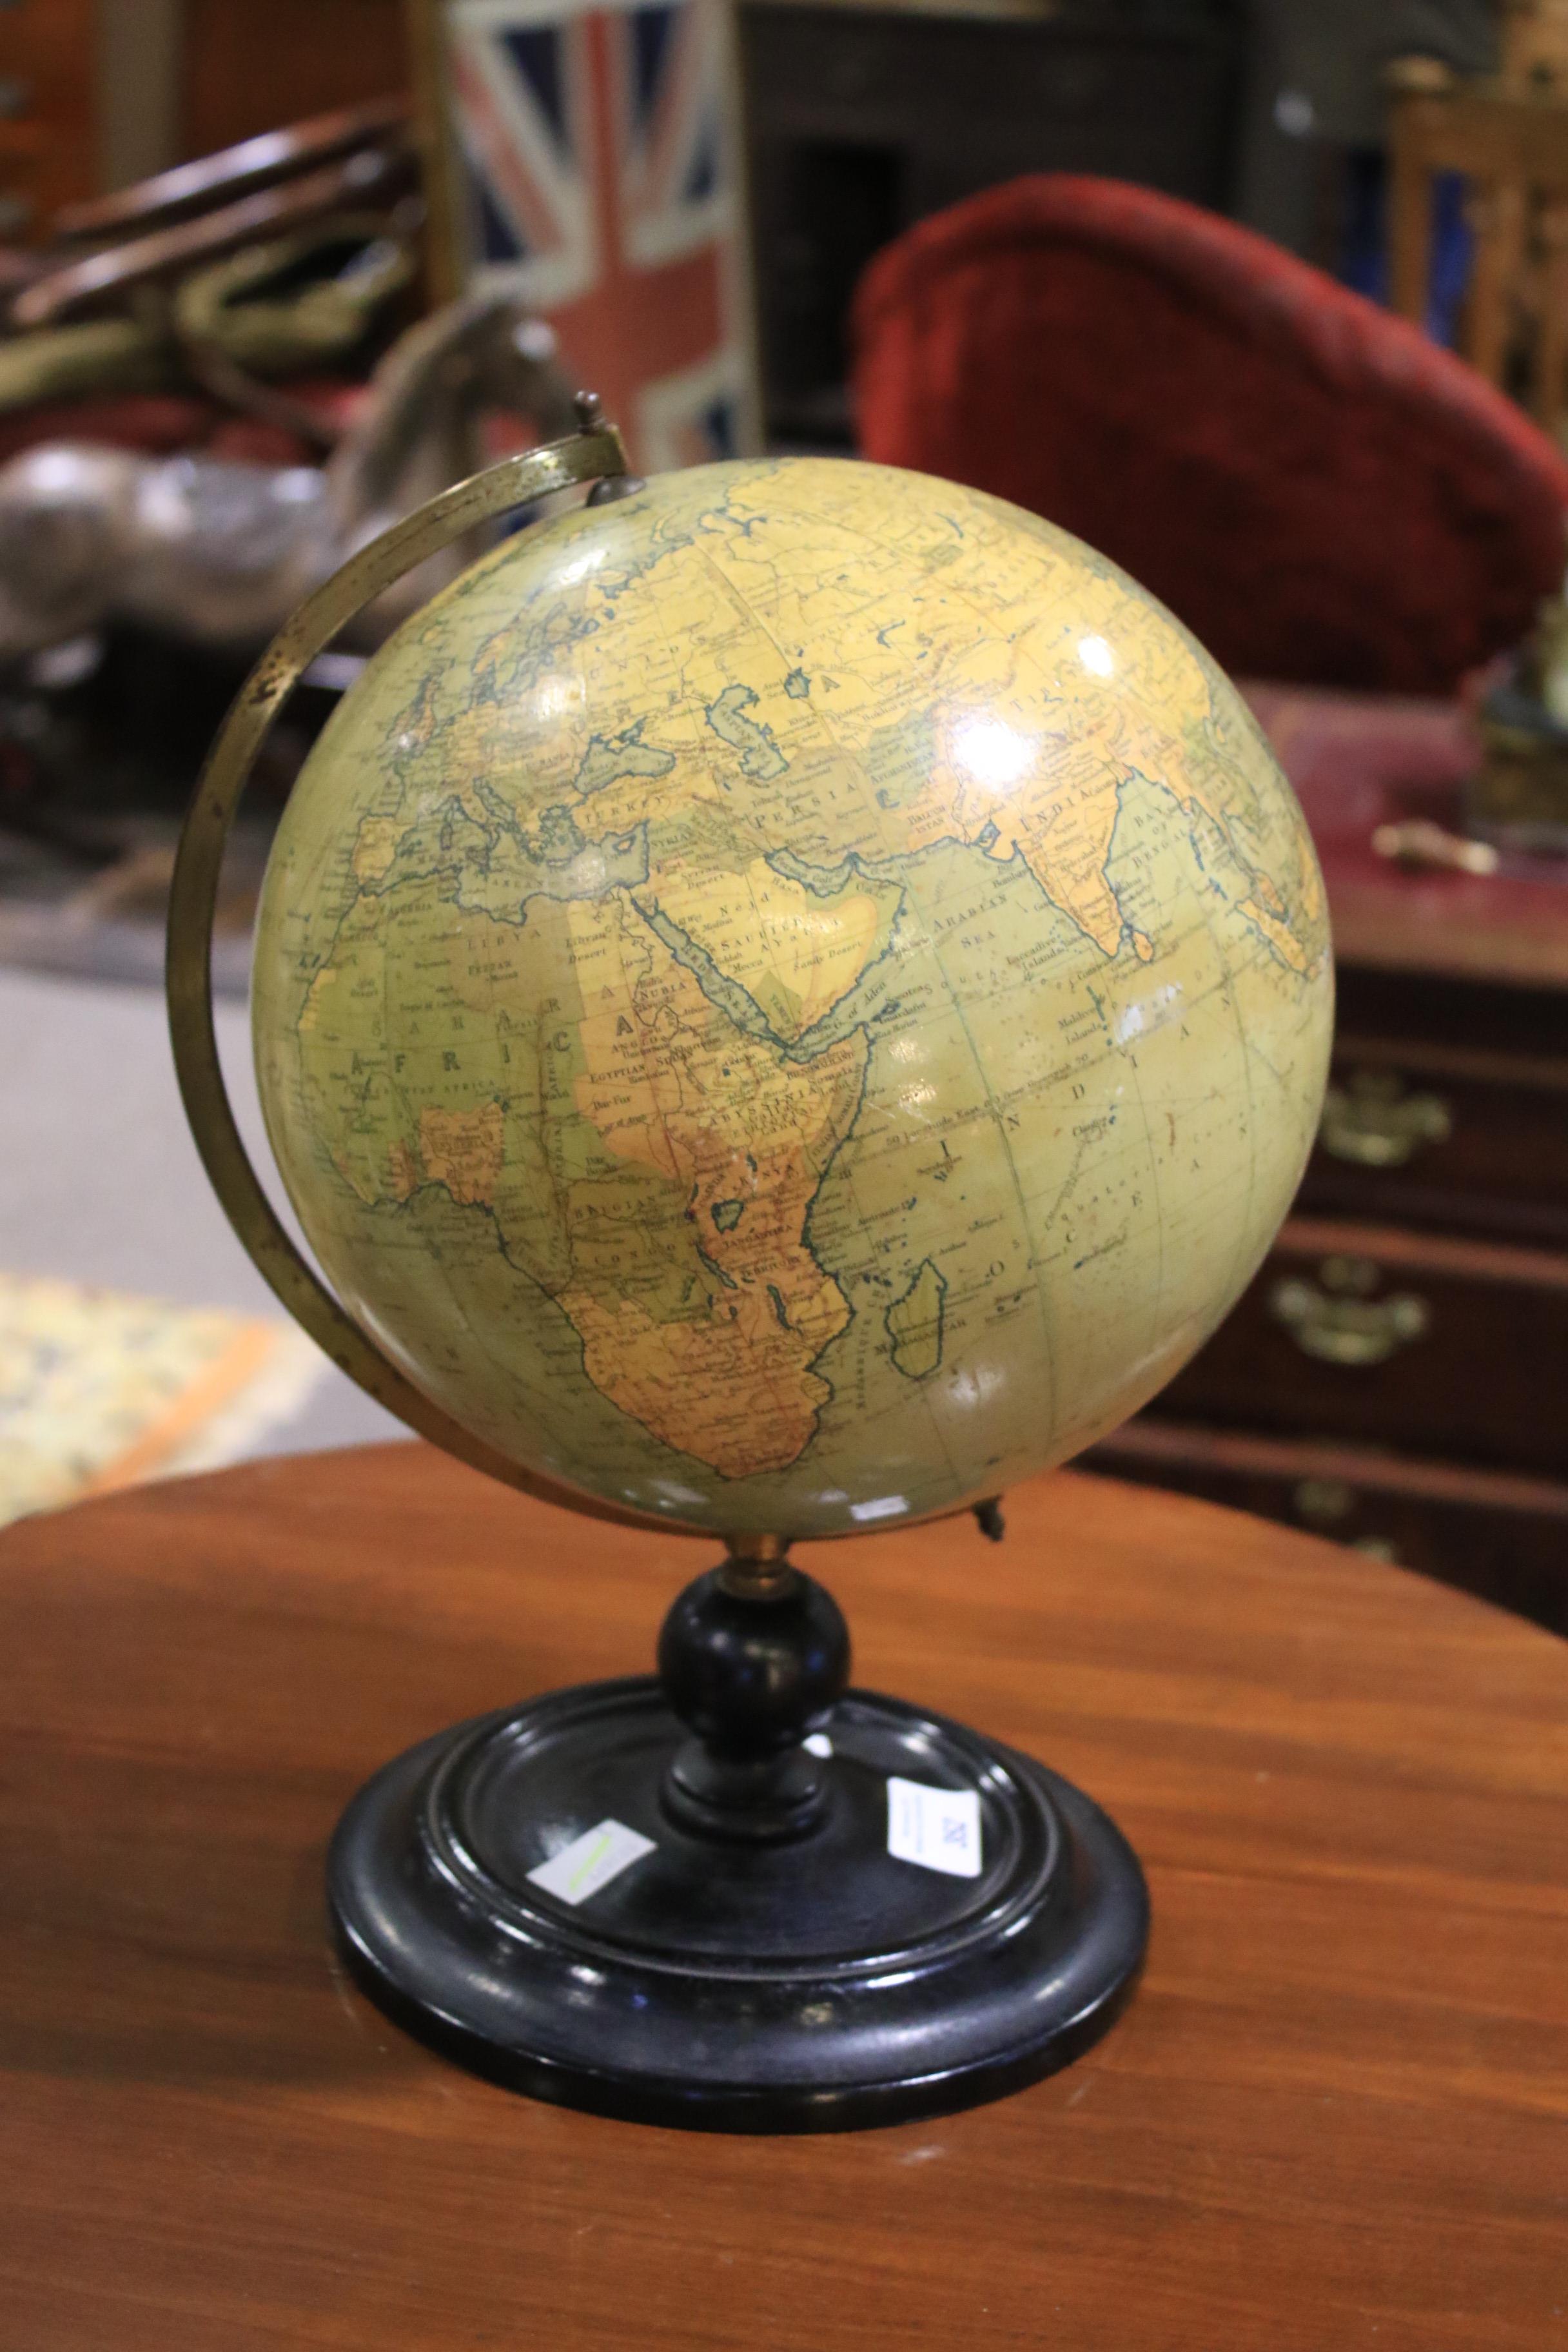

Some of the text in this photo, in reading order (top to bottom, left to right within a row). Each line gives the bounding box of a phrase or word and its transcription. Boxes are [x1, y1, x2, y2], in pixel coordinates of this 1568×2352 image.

[754, 781, 856, 830] PERSIA
[1019, 789, 1090, 832] INDIA
[1133, 806, 1166, 828] BAY
[1152, 821, 1168, 836] OF
[1132, 828, 1188, 868] BENGAL
[932, 892, 1008, 934] ARABIAN
[828, 941, 863, 958] Desert
[961, 930, 996, 949] SEA
[639, 981, 687, 1001] NUBIA
[589, 1063, 645, 1083] EGYPTIAN
[709, 1087, 817, 1127] ABYSSINIA
[956, 1105, 979, 1117] East
